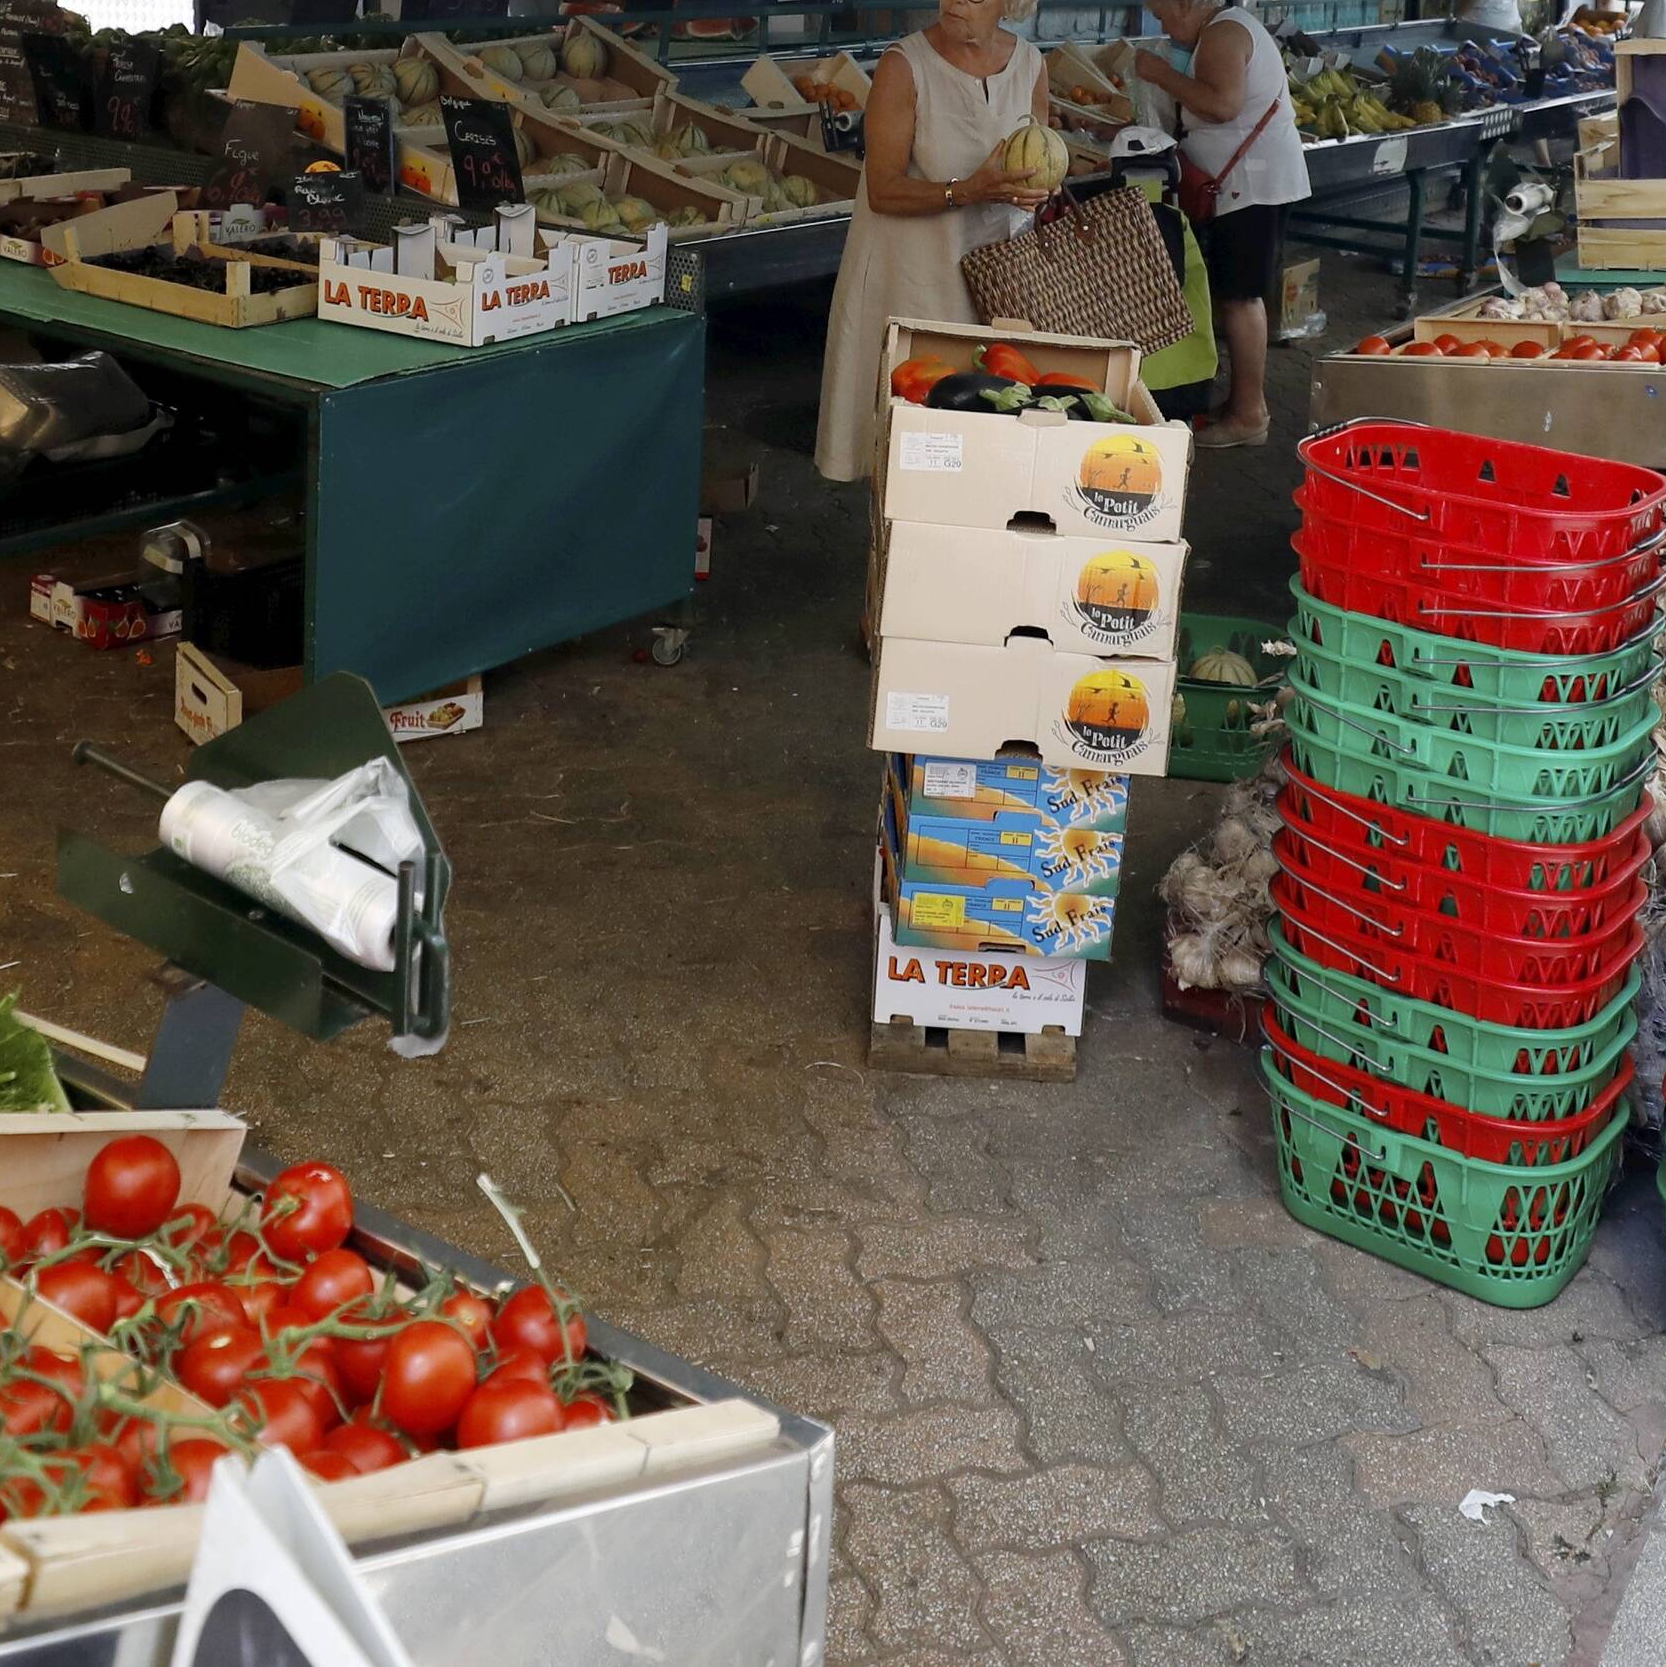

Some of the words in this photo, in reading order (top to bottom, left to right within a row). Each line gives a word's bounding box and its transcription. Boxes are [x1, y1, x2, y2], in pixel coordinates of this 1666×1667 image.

[608, 260, 647, 285] TERRA
[324, 279, 351, 308] LA
[358, 285, 429, 322] TERRA
[482, 290, 501, 312] LA
[506, 280, 550, 307] TERRA
[1083, 504, 1161, 532] Camarguais
[1103, 497, 1139, 515] Petit
[1080, 620, 1158, 647] Camarguais
[1100, 613, 1136, 632] Petit
[389, 710, 426, 731] Fruit
[1071, 739, 1149, 766] Camarguais
[1091, 731, 1128, 750] Petit
[1046, 790, 1078, 814] Sud
[1081, 774, 1123, 798] Frais
[1039, 854, 1072, 879] Sud
[1074, 838, 1116, 862] Frais
[1032, 921, 1064, 943] Sud
[1065, 905, 1107, 927] Frais
[888, 956, 926, 984] LA
[935, 959, 1031, 991] TERRA
